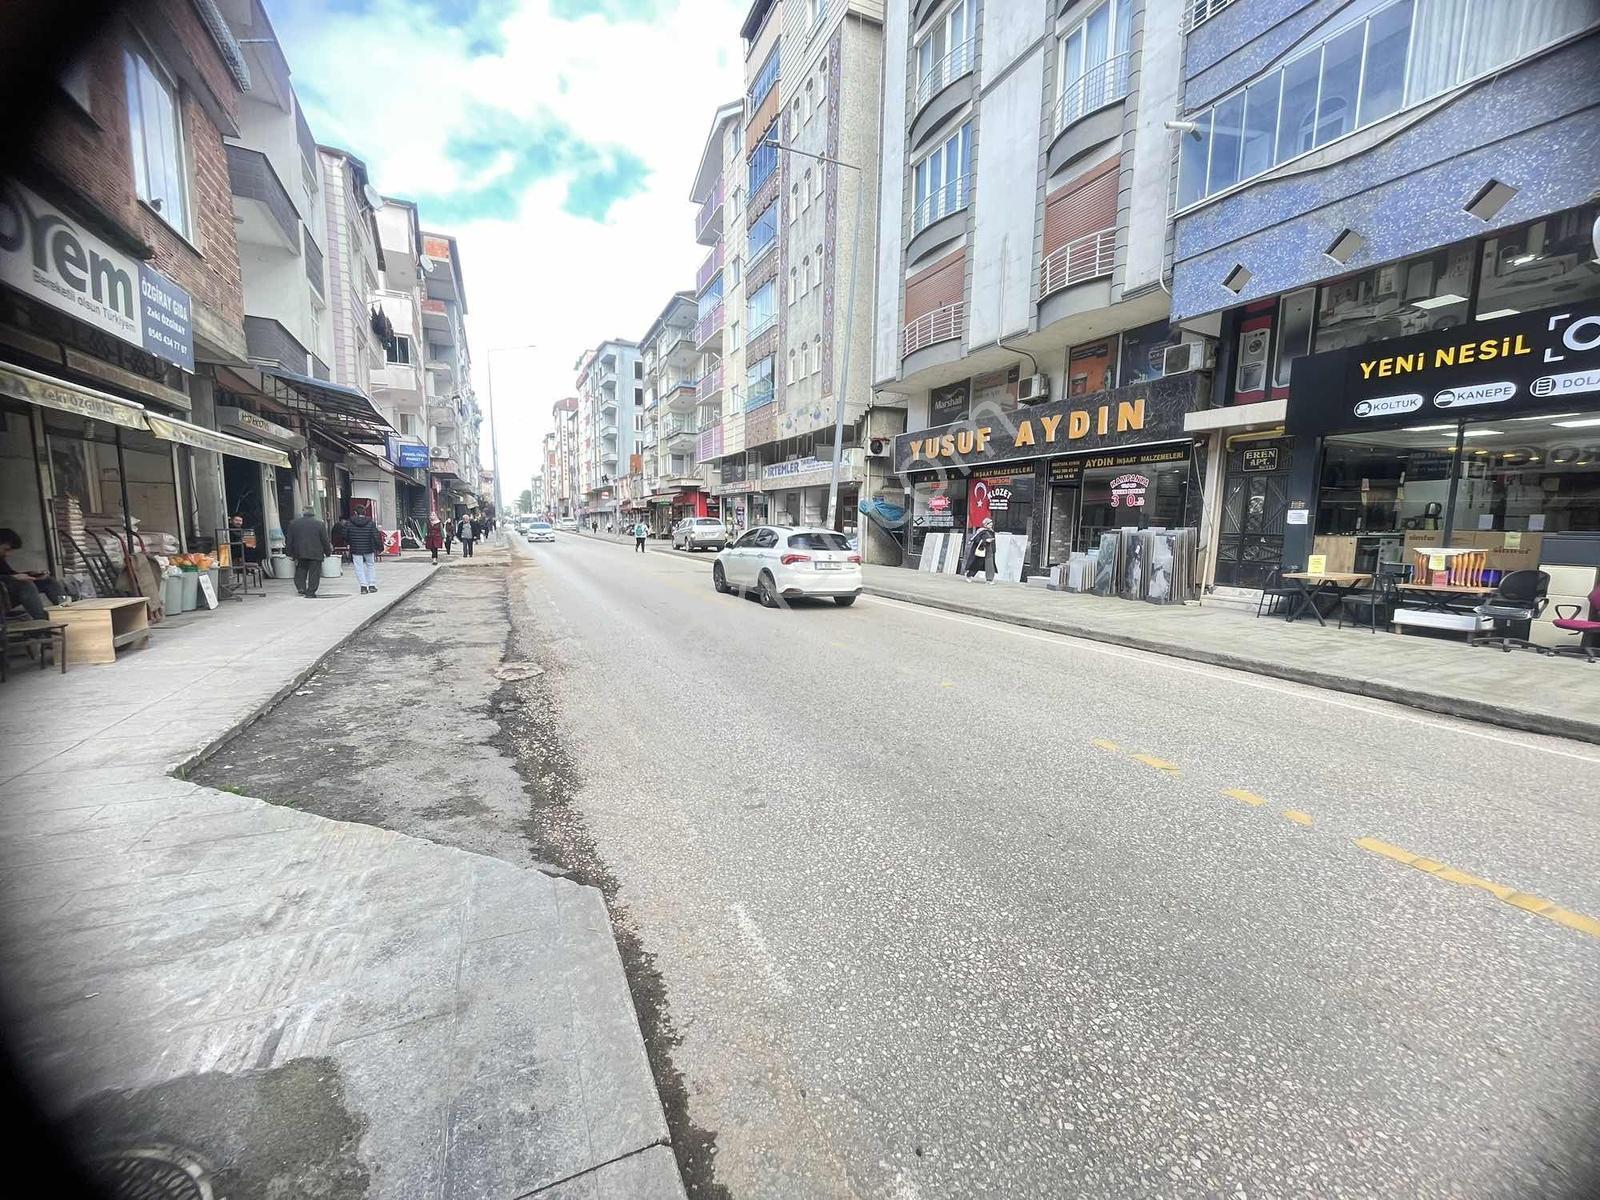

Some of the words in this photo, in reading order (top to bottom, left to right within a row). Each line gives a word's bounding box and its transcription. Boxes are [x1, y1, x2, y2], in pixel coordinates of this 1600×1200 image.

[77, 295, 102, 316] olsun
[172, 300, 189, 322] GIDA
[1457, 386, 1513, 401] KANEPE
[1372, 398, 1419, 412] KOLTUK
[910, 427, 991, 461] YUSUF
[1014, 399, 1146, 447] AYDIN
[1245, 450, 1276, 460] EREN
[1085, 457, 1114, 468] AYDIN
[987, 487, 1013, 501] KLOZET
